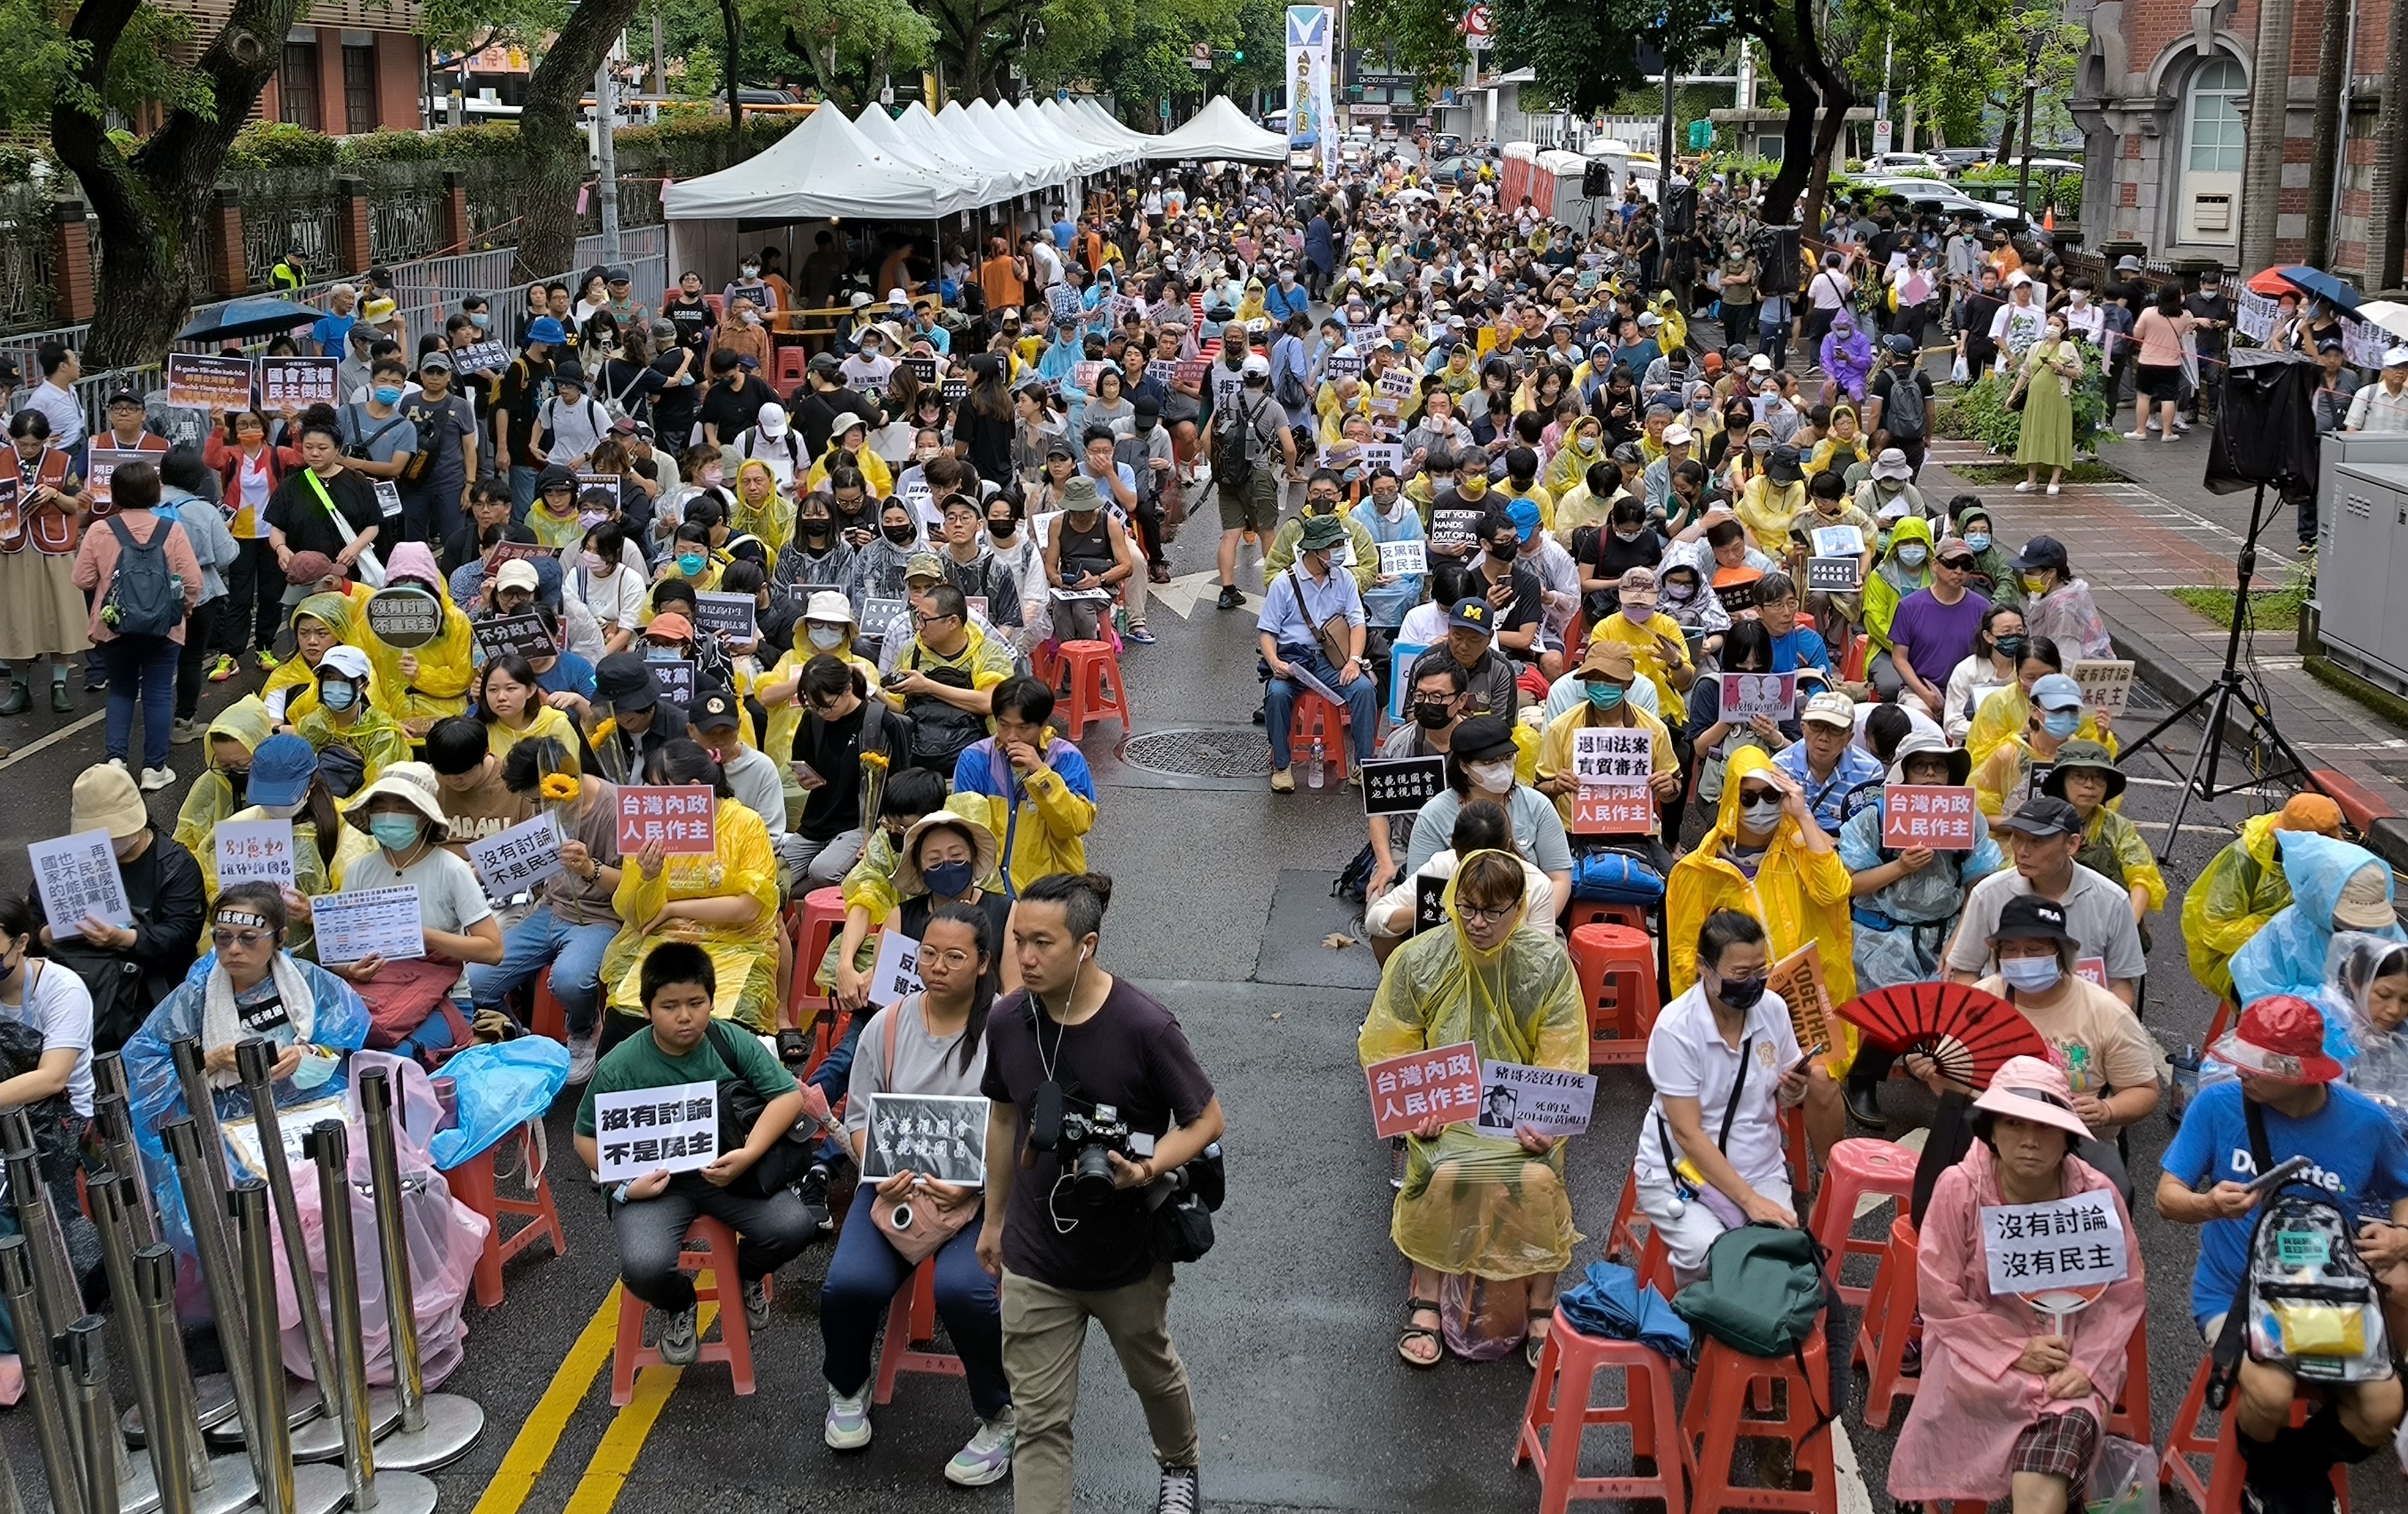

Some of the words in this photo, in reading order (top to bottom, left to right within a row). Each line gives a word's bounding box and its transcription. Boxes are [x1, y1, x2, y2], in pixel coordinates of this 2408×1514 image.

[268, 367, 334, 383] 國會濫權
[269, 384, 333, 398] 民主倒退
[1452, 512, 1477, 520] YOUR
[1382, 544, 1421, 559] 反黑箱
[371, 598, 435, 617] 沒有討論
[1463, 604, 1483, 621] M
[371, 616, 436, 634] 不是民主
[477, 619, 542, 643] 不分政黨
[485, 636, 550, 660] 同島一命
[655, 668, 690, 684] 政黨
[2075, 667, 2130, 682] 沒有討論
[660, 686, 690, 703] 一命
[2082, 687, 2123, 706] 是民主
[1578, 735, 1649, 755] 退回法案
[1578, 757, 1649, 777] 實質審查
[1370, 771, 1435, 788] 我藐視國會
[1578, 785, 1647, 801] 台灣內政
[1890, 793, 1971, 813] 台灣內政
[622, 794, 709, 815] 台灣內政
[1577, 804, 1647, 822] 人民作主
[622, 818, 709, 840] 人民作主
[1888, 817, 1969, 837] 人民作主
[479, 827, 556, 870] 沒有討論
[490, 848, 562, 887] 不是民主
[79, 861, 102, 904] 民進黨
[91, 843, 122, 914] 再怎麼討厭
[40, 855, 74, 925] 國家的未來
[2038, 909, 2061, 922] FILA
[1791, 958, 1832, 1054] TOGETHER
[1374, 1053, 1473, 1095] 台灣內政
[1494, 1066, 1585, 1091] 豬哥亮沒有死
[1381, 1082, 1477, 1122] 人民作主
[1534, 1101, 1571, 1114] 死的是
[601, 1097, 714, 1132] 沒有討論
[1517, 1111, 1587, 1127] 2014的黃國昌
[878, 1117, 969, 1137] 我藐視國會
[603, 1131, 714, 1166] 不是民主
[875, 1138, 966, 1158] 也藐視國昌
[1997, 1204, 2108, 1240] 沒有討論
[2003, 1244, 2114, 1278] 沒有民主
